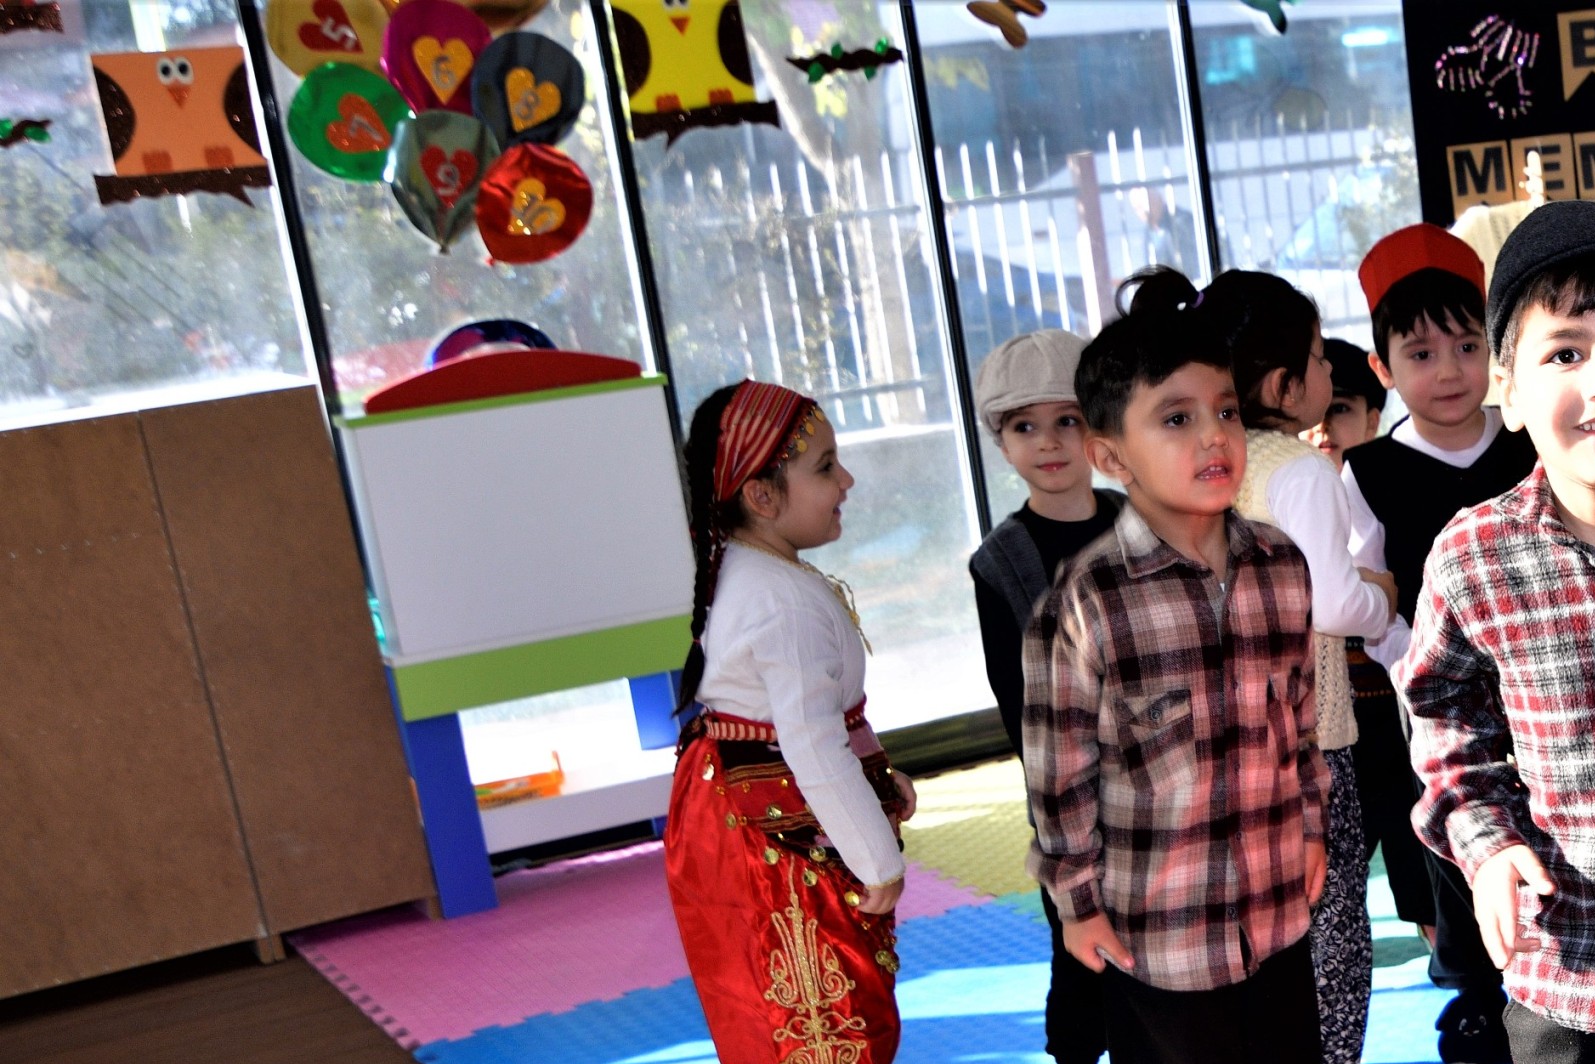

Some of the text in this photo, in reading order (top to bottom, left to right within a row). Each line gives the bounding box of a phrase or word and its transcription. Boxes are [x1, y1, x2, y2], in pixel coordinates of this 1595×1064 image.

[432, 54, 456, 90] 6
[515, 89, 540, 121] 8
[437, 163, 460, 195] 9
